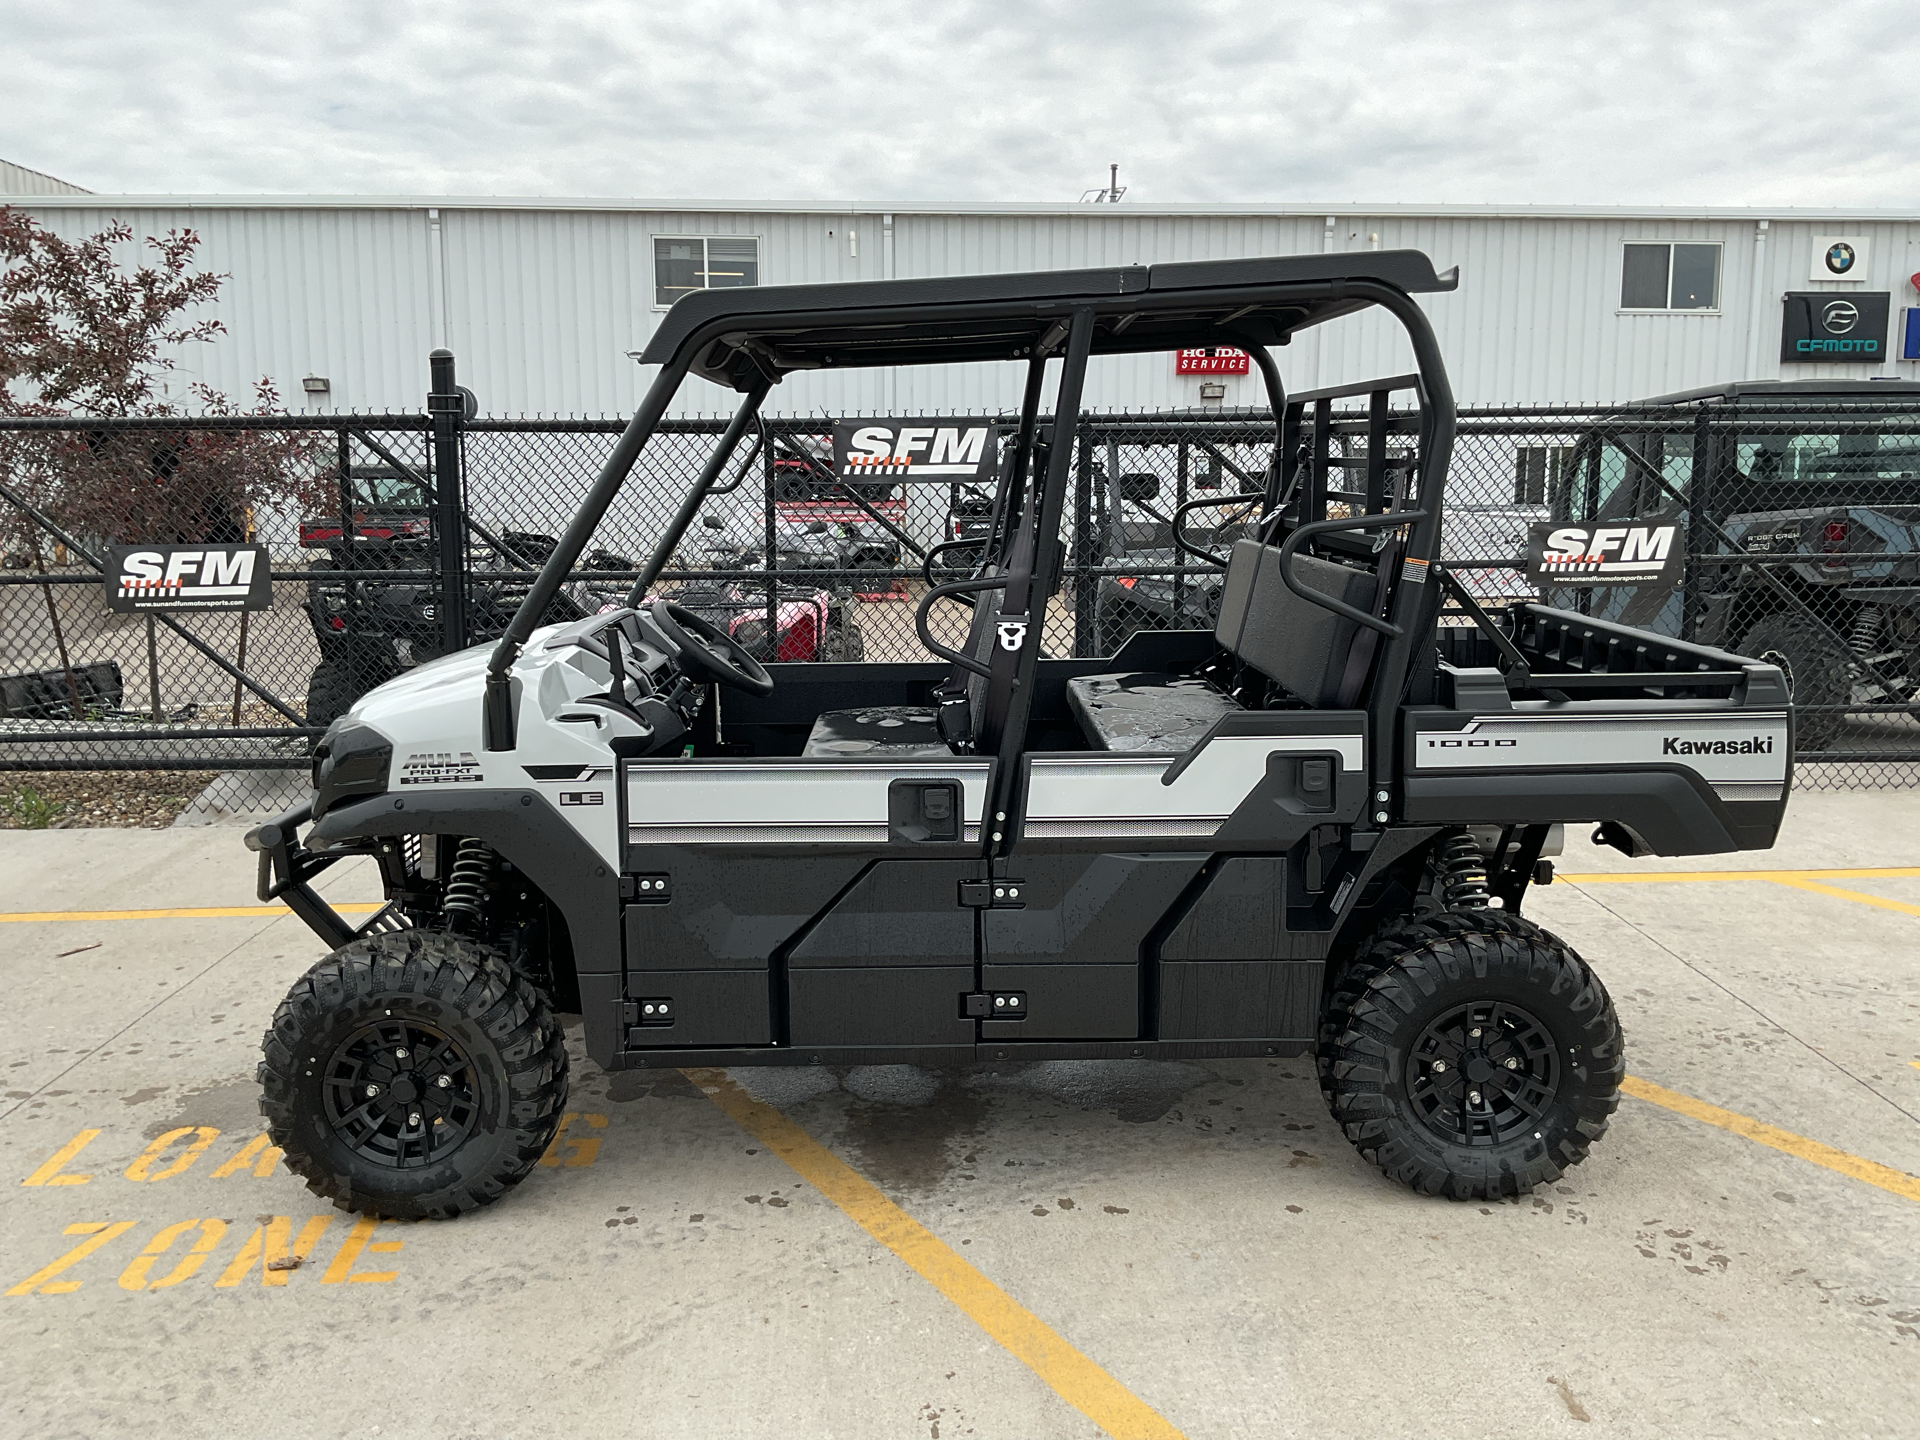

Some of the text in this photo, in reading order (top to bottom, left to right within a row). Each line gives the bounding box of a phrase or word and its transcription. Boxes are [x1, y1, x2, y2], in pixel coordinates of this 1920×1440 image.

[1829, 244, 1853, 254] BMW
[1796, 340, 1878, 352] CFMOTO
[1181, 359, 1246, 369] SERVICE
[846, 427, 988, 464] SFM
[1543, 526, 1675, 562] SFM
[119, 551, 256, 588] SFM
[1554, 574, 1658, 582] www.sunandfunmotorsports.com
[135, 599, 245, 607] www.sunandfunmotorsports.com
[1427, 739, 1517, 748] 1000
[1662, 736, 1773, 755] Kawasaki
[402, 752, 481, 769] MULE
[561, 793, 603, 805] LE
[2, 1214, 405, 1297] ZONE
